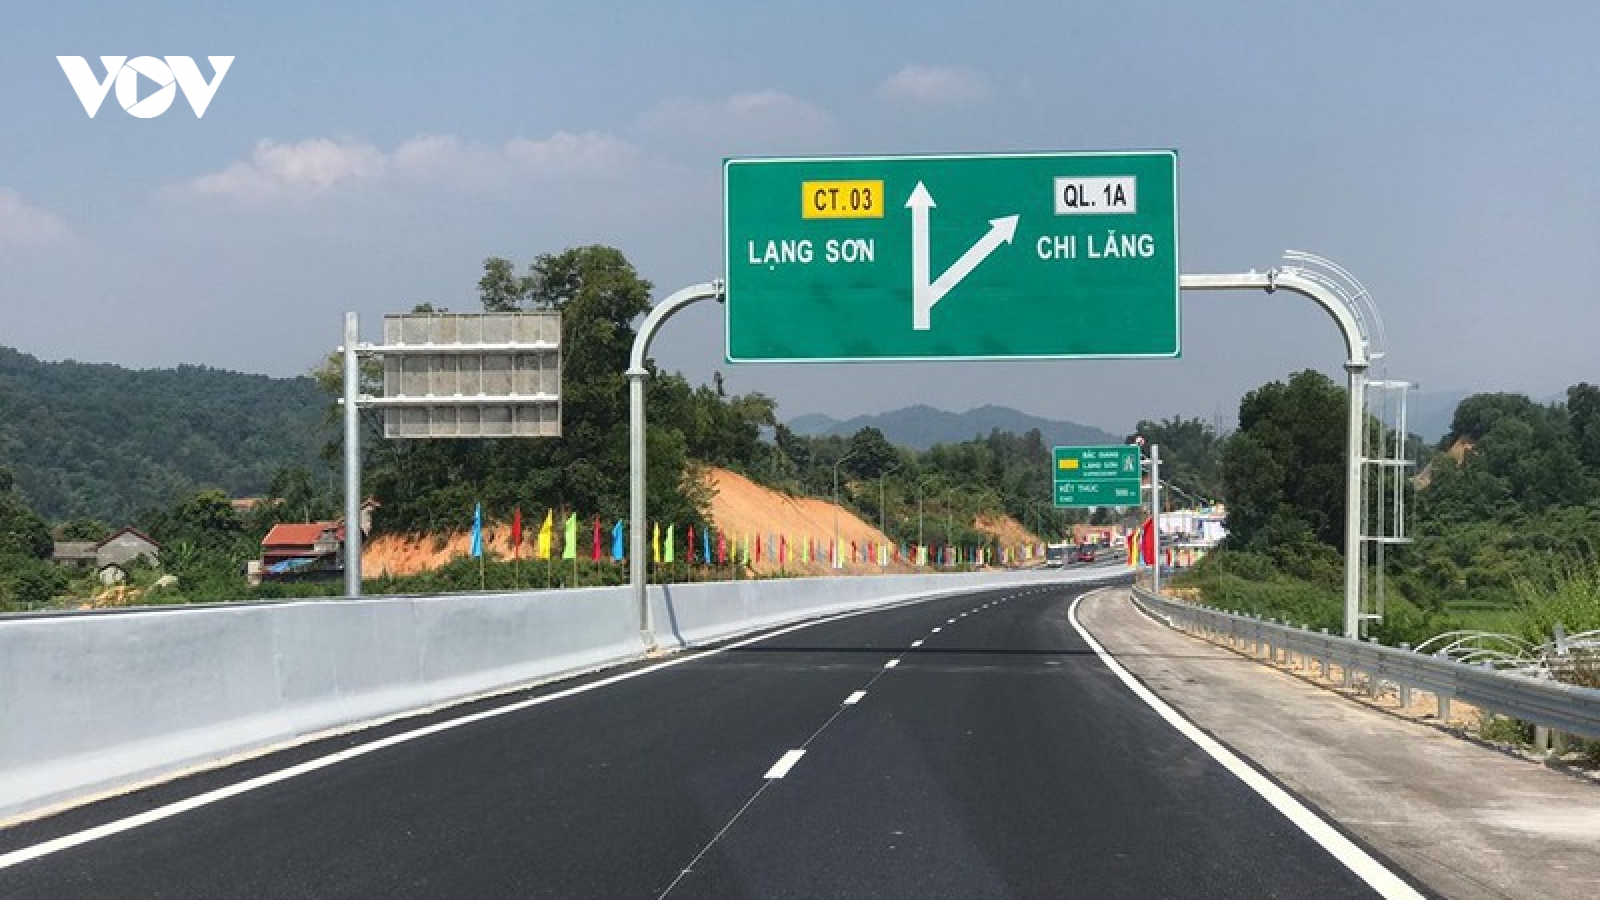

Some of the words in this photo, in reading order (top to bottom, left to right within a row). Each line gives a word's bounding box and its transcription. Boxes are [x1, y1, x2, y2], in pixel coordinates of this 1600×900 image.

[815, 187, 871, 211] CT.03
[1103, 183, 1127, 207] 1A
[749, 240, 813, 270] LẠNG
[825, 239, 875, 263] SƠN
[1037, 235, 1076, 259] CHI
[1087, 230, 1155, 258] LĂNG
